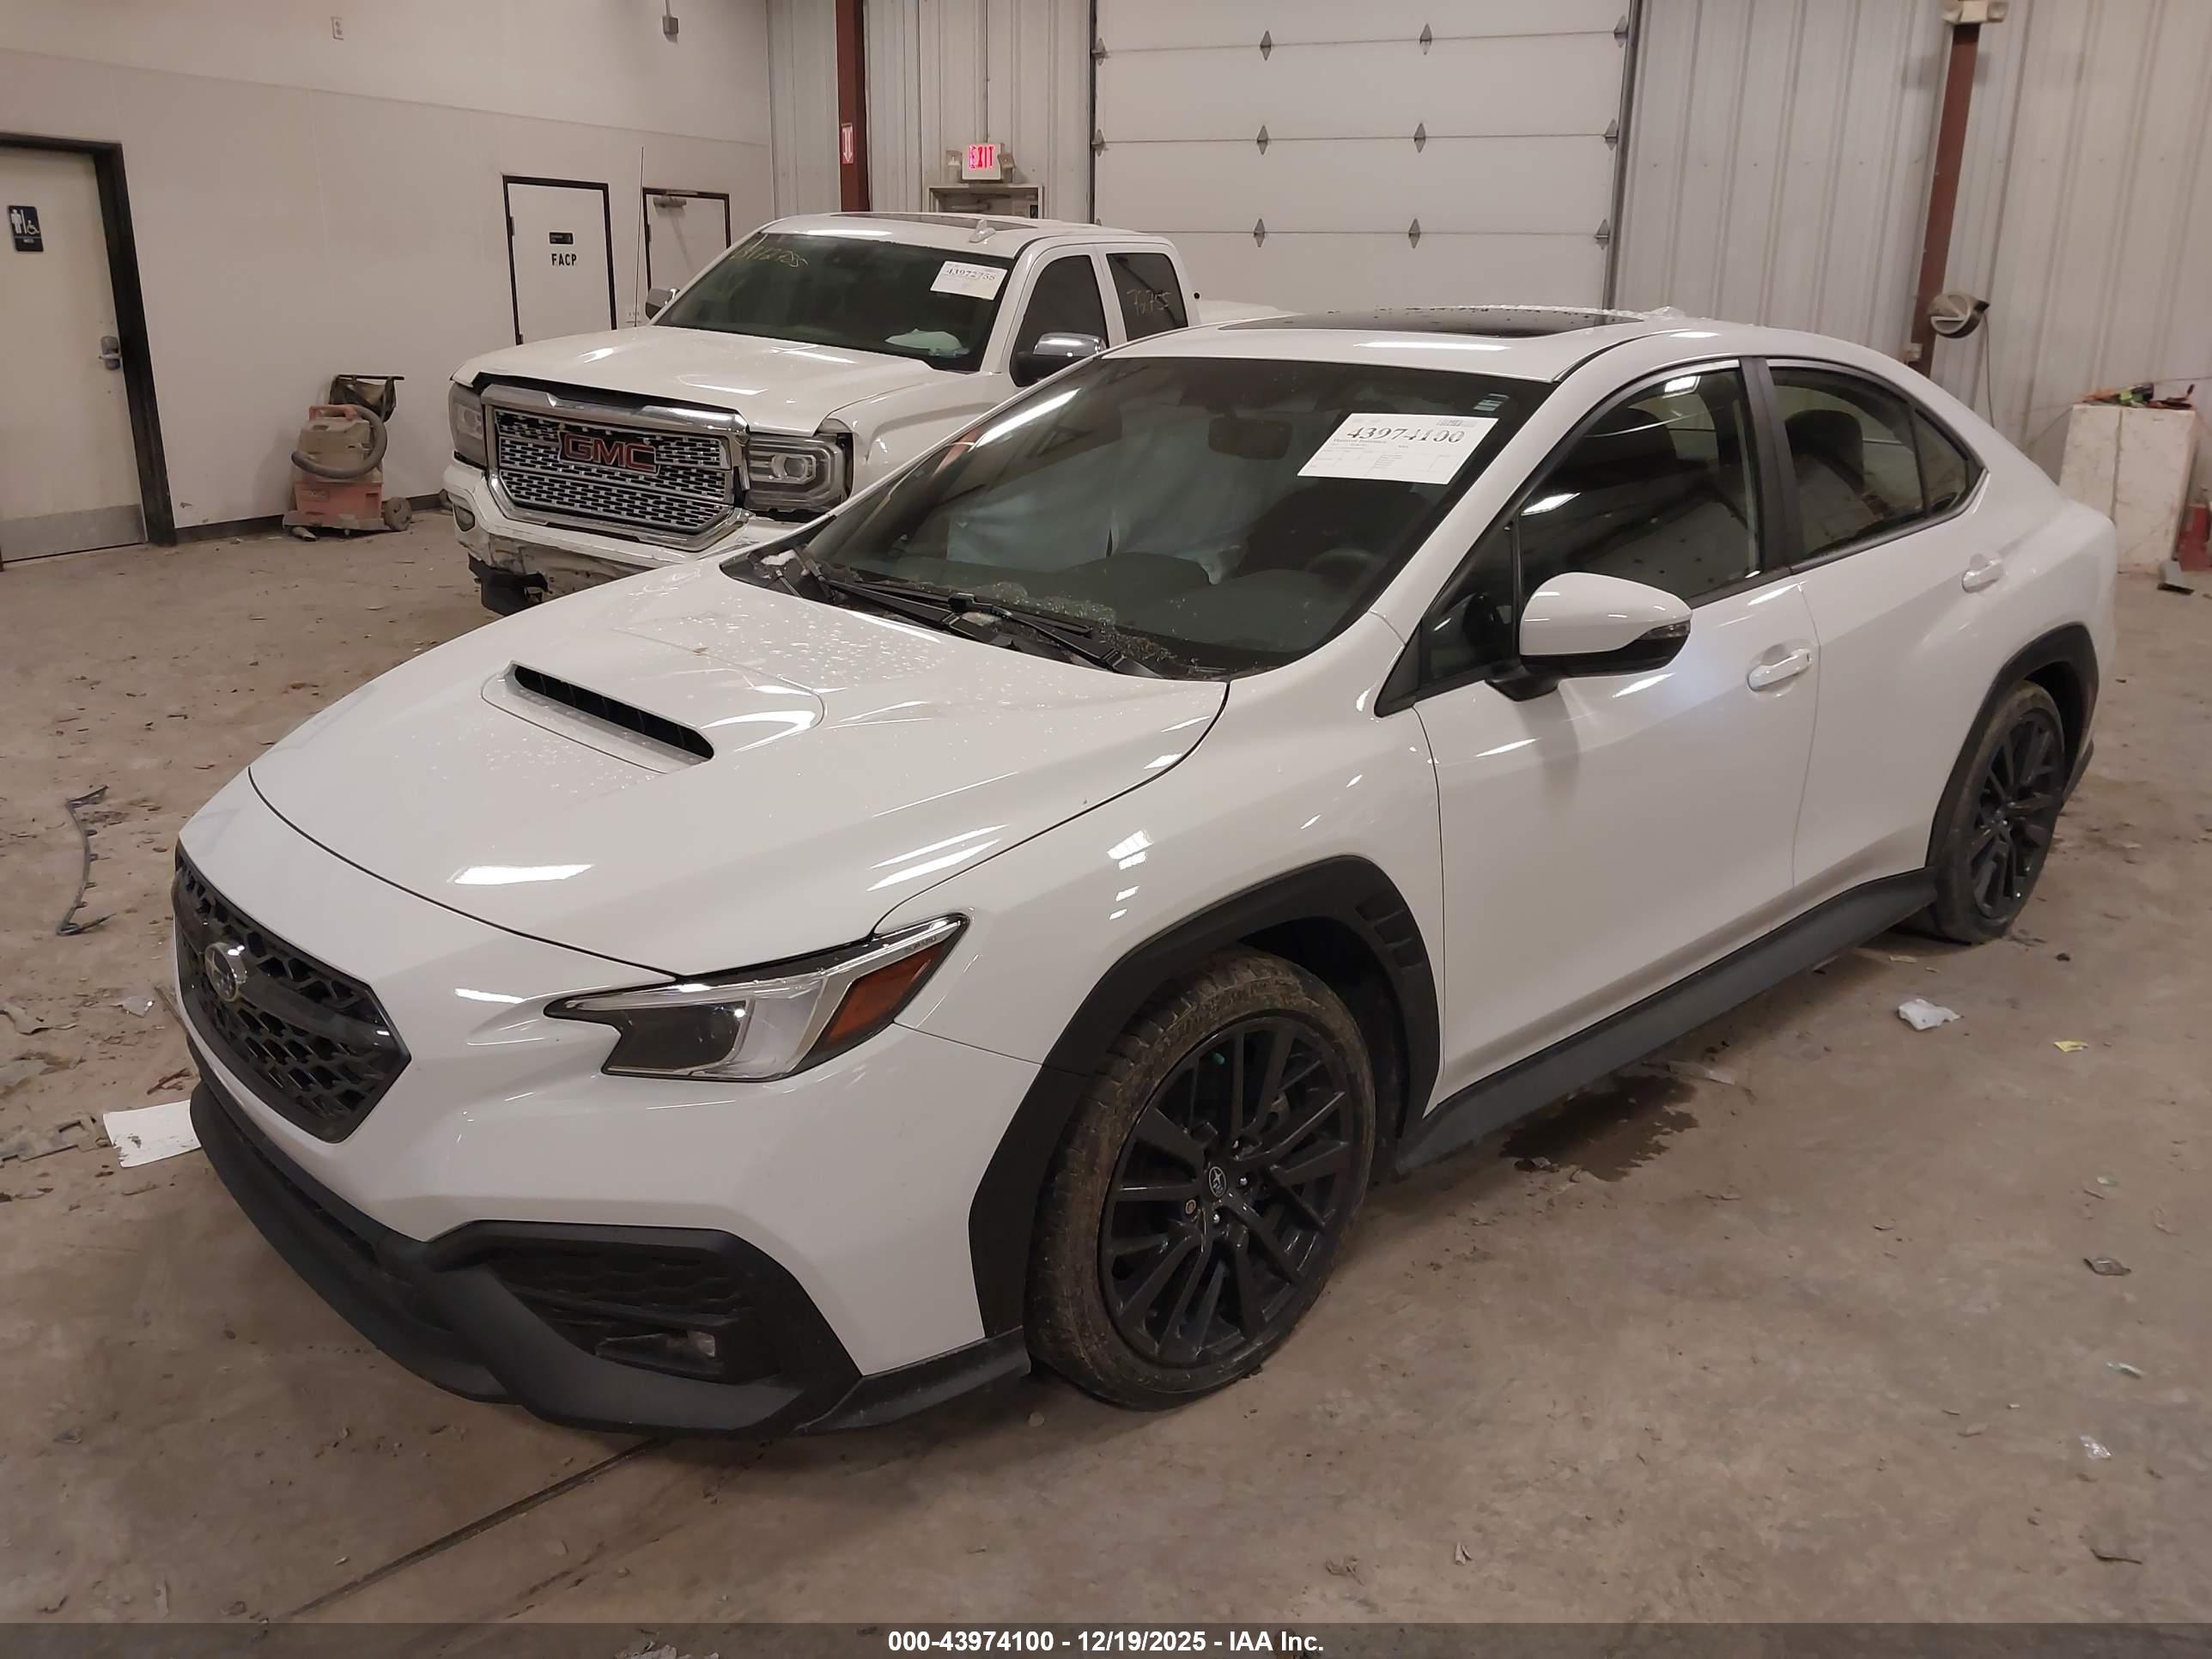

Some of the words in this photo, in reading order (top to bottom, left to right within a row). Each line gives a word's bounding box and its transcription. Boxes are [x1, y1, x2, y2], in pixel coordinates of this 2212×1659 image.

[969, 145, 995, 169] EXIT
[550, 252, 578, 266] FACP
[1346, 427, 1465, 443] 43974100
[563, 433, 657, 473] GMC
